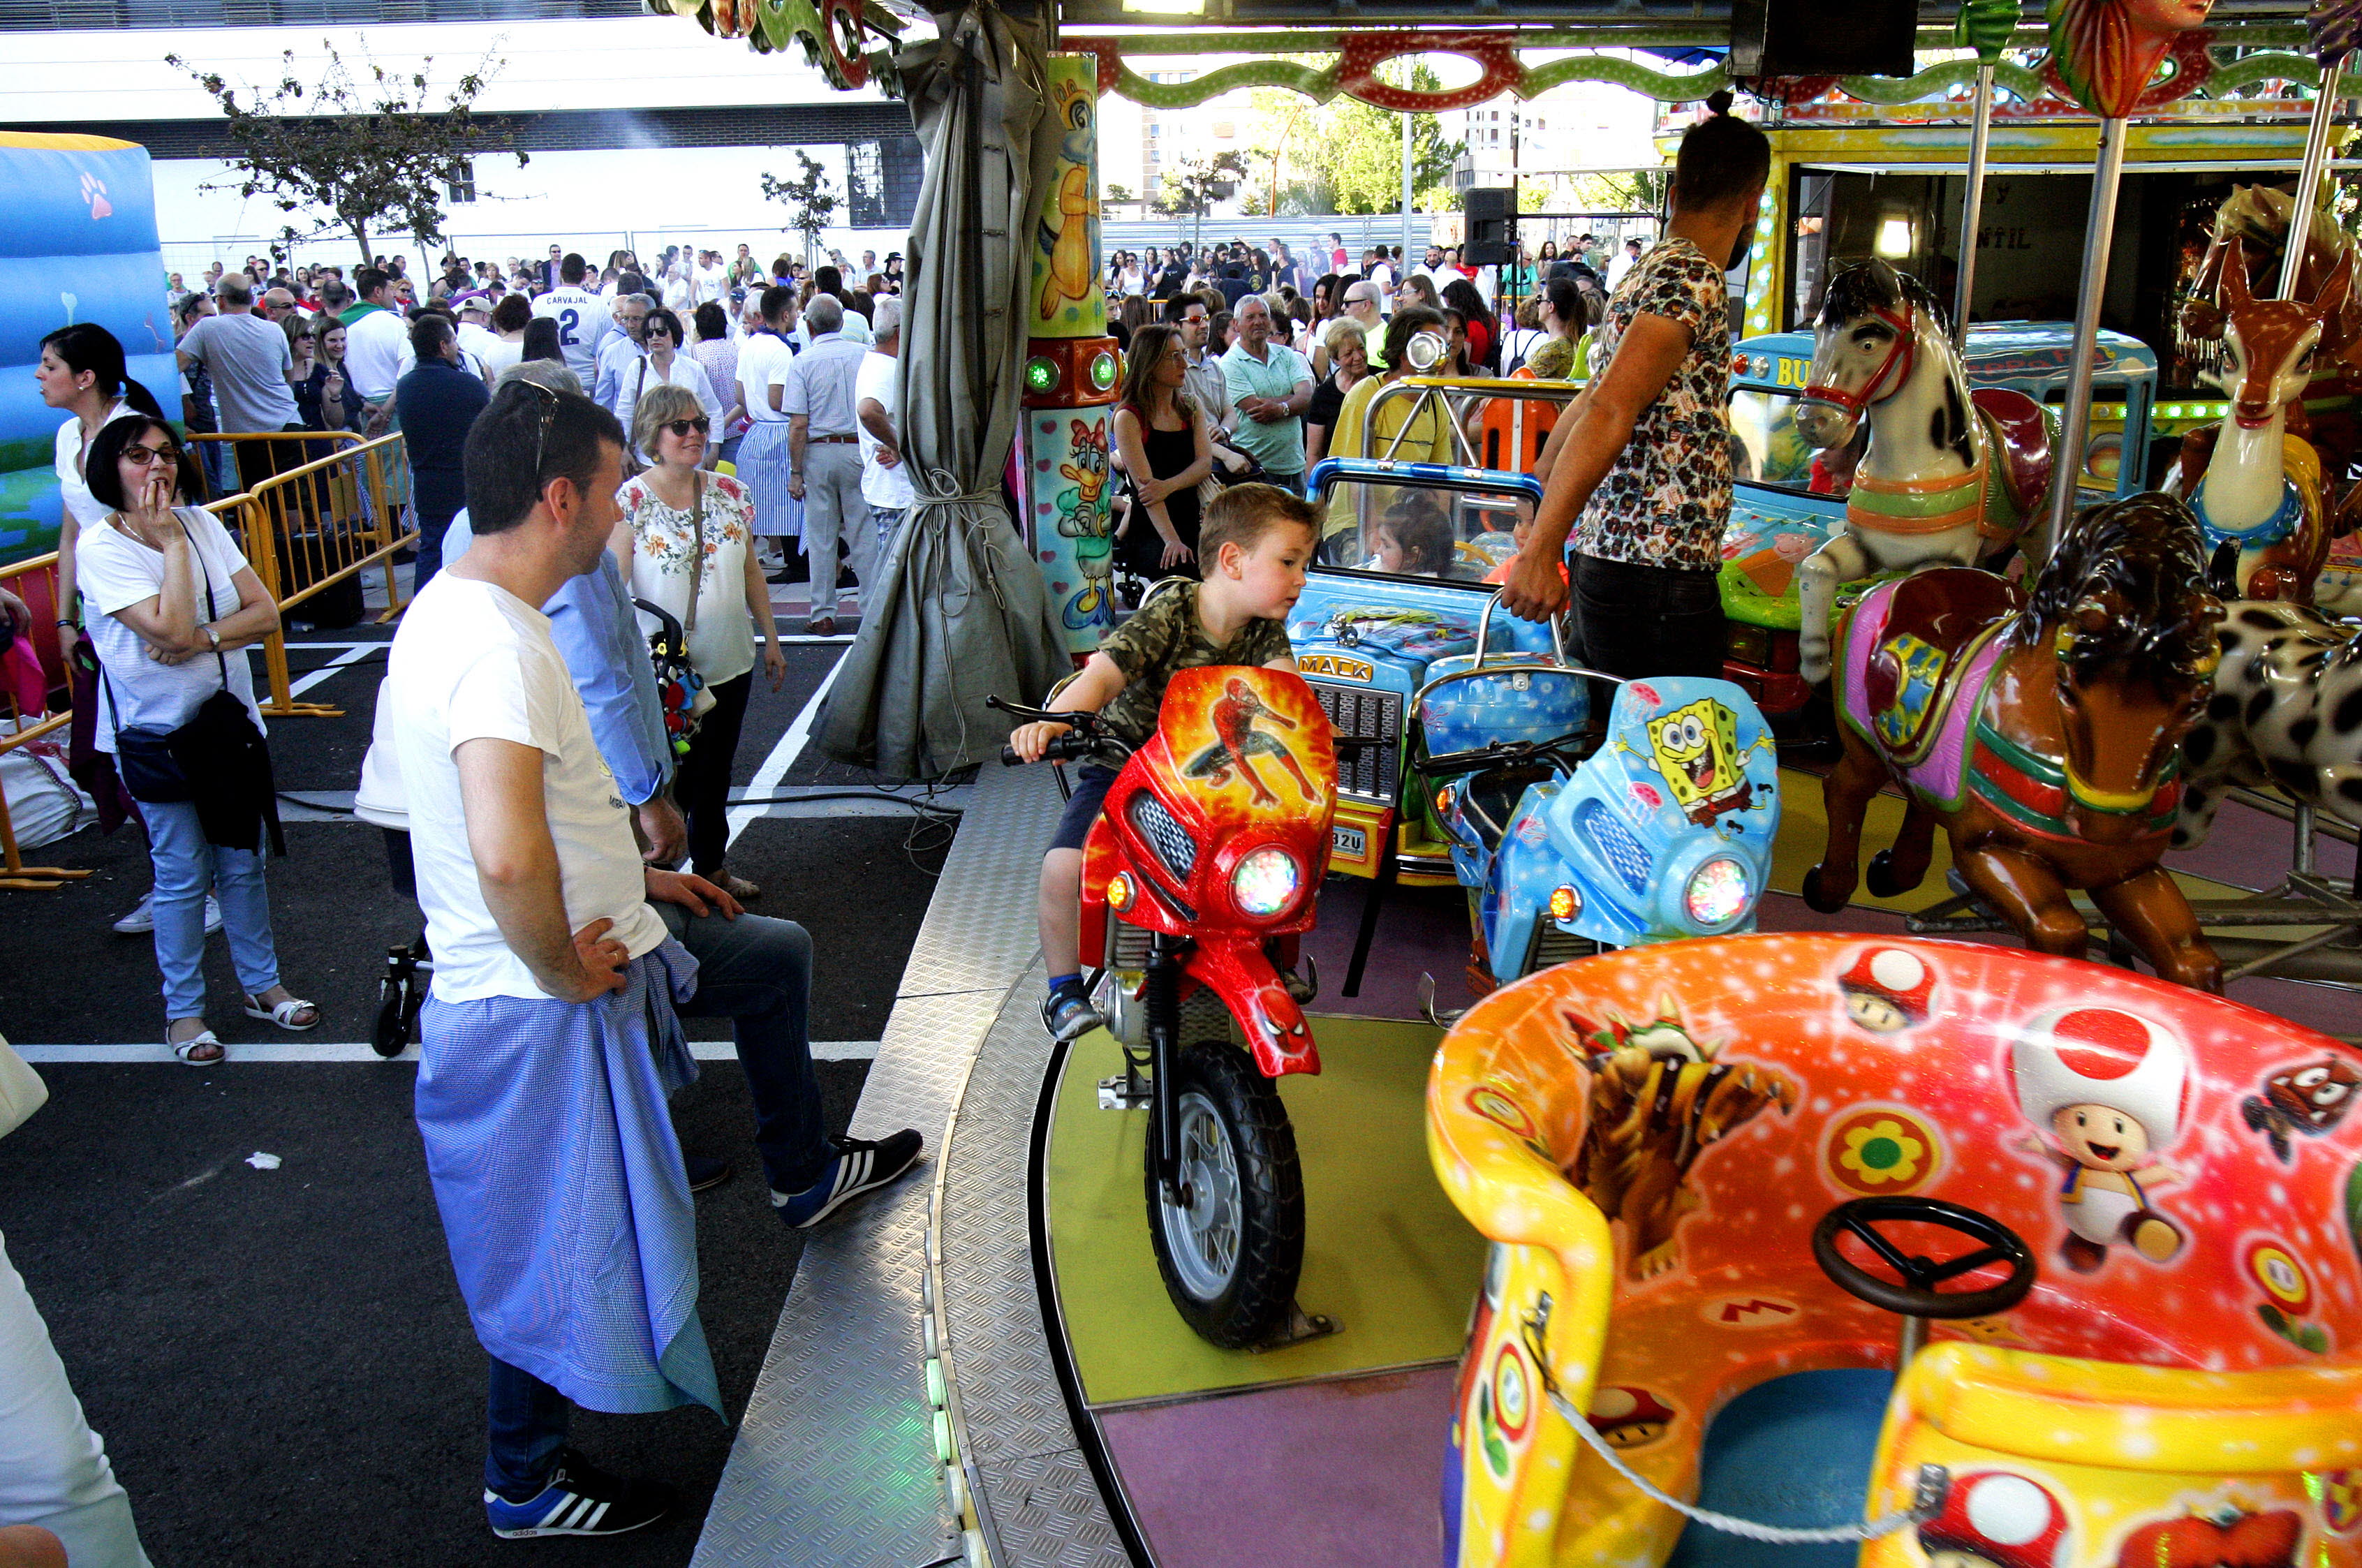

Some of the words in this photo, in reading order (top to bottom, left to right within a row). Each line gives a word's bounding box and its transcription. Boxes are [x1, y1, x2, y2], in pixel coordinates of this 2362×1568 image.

[547, 297, 588, 305] CARVAJAL
[559, 308, 580, 346] 2
[1301, 657, 1369, 679] MACK
